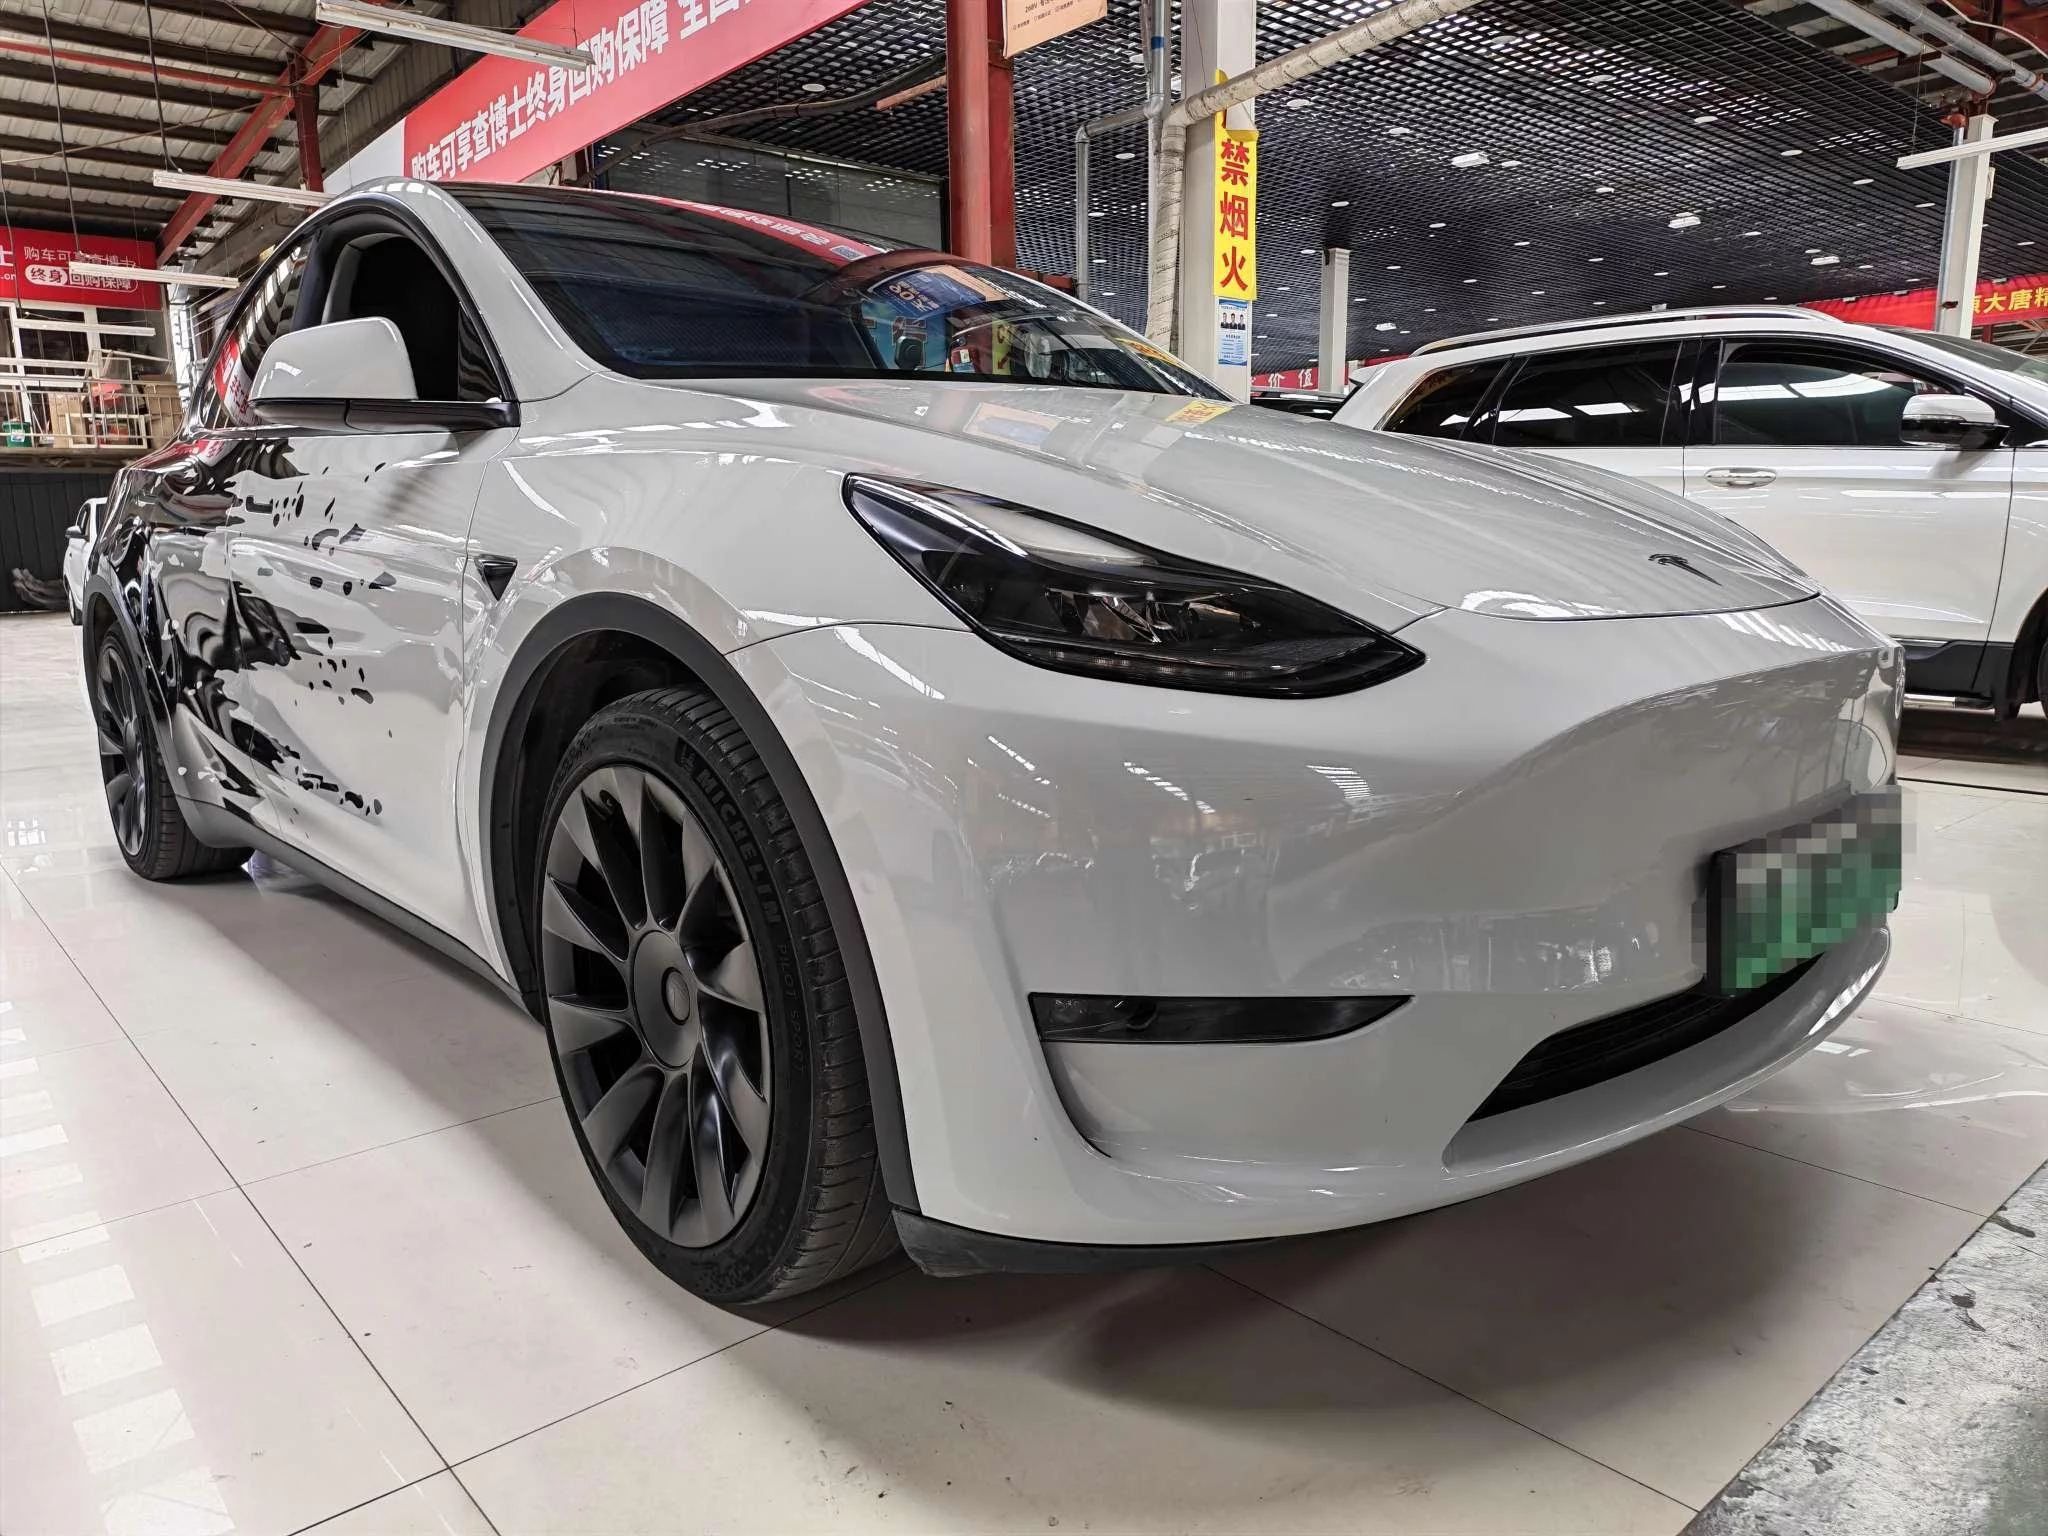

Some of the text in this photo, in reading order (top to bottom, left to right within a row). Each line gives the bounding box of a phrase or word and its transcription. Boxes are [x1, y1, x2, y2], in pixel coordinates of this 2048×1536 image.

[1219, 108, 1250, 292] 禁烟火
[1250, 368, 1313, 389] 价值
[696, 768, 783, 925] MICHELIN
[776, 943, 807, 1074] PILOT SPORT
